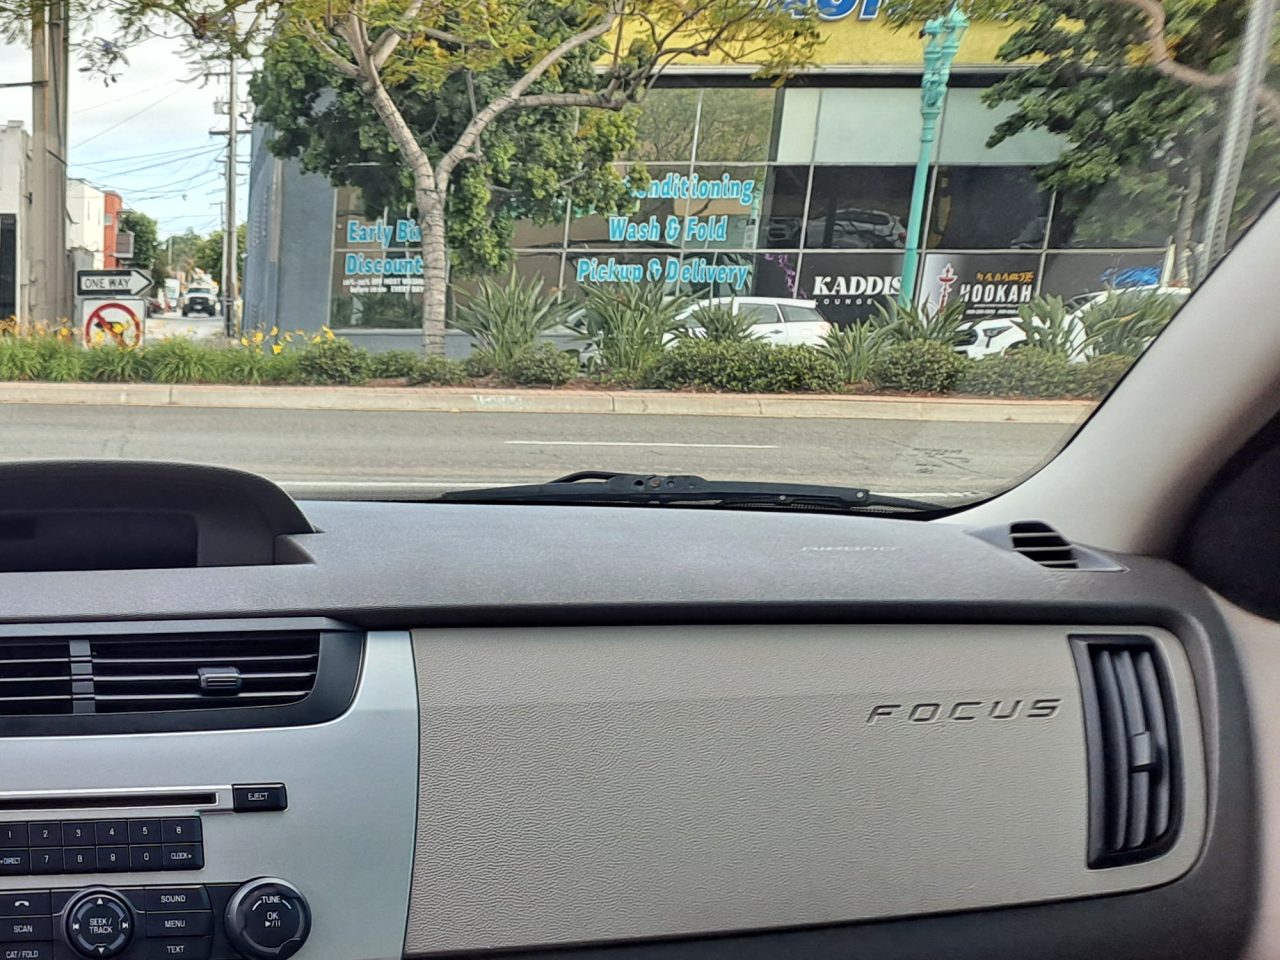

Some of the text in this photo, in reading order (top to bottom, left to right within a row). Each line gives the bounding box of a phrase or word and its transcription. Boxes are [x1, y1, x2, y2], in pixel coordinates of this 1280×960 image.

[347, 217, 394, 249] Early
[608, 215, 728, 242] Wash & Fold
[576, 258, 644, 283] Pickup
[665, 258, 749, 290] Delivery
[84, 278, 131, 289] ONE WAY
[812, 276, 903, 296] KADDIS
[960, 284, 1033, 303] HOOKAH
[866, 699, 1062, 724] FOCUS
[248, 792, 269, 801] EJECT
[160, 895, 186, 903] SOUND
[267, 911, 278, 920] OK
[165, 920, 185, 928] MENU
[13, 925, 33, 933] SCAN
[89, 926, 113, 934] TRACK
[167, 945, 184, 953] TEXT
[6, 951, 17, 959] CAT
[22, 950, 38, 958] FOLD
